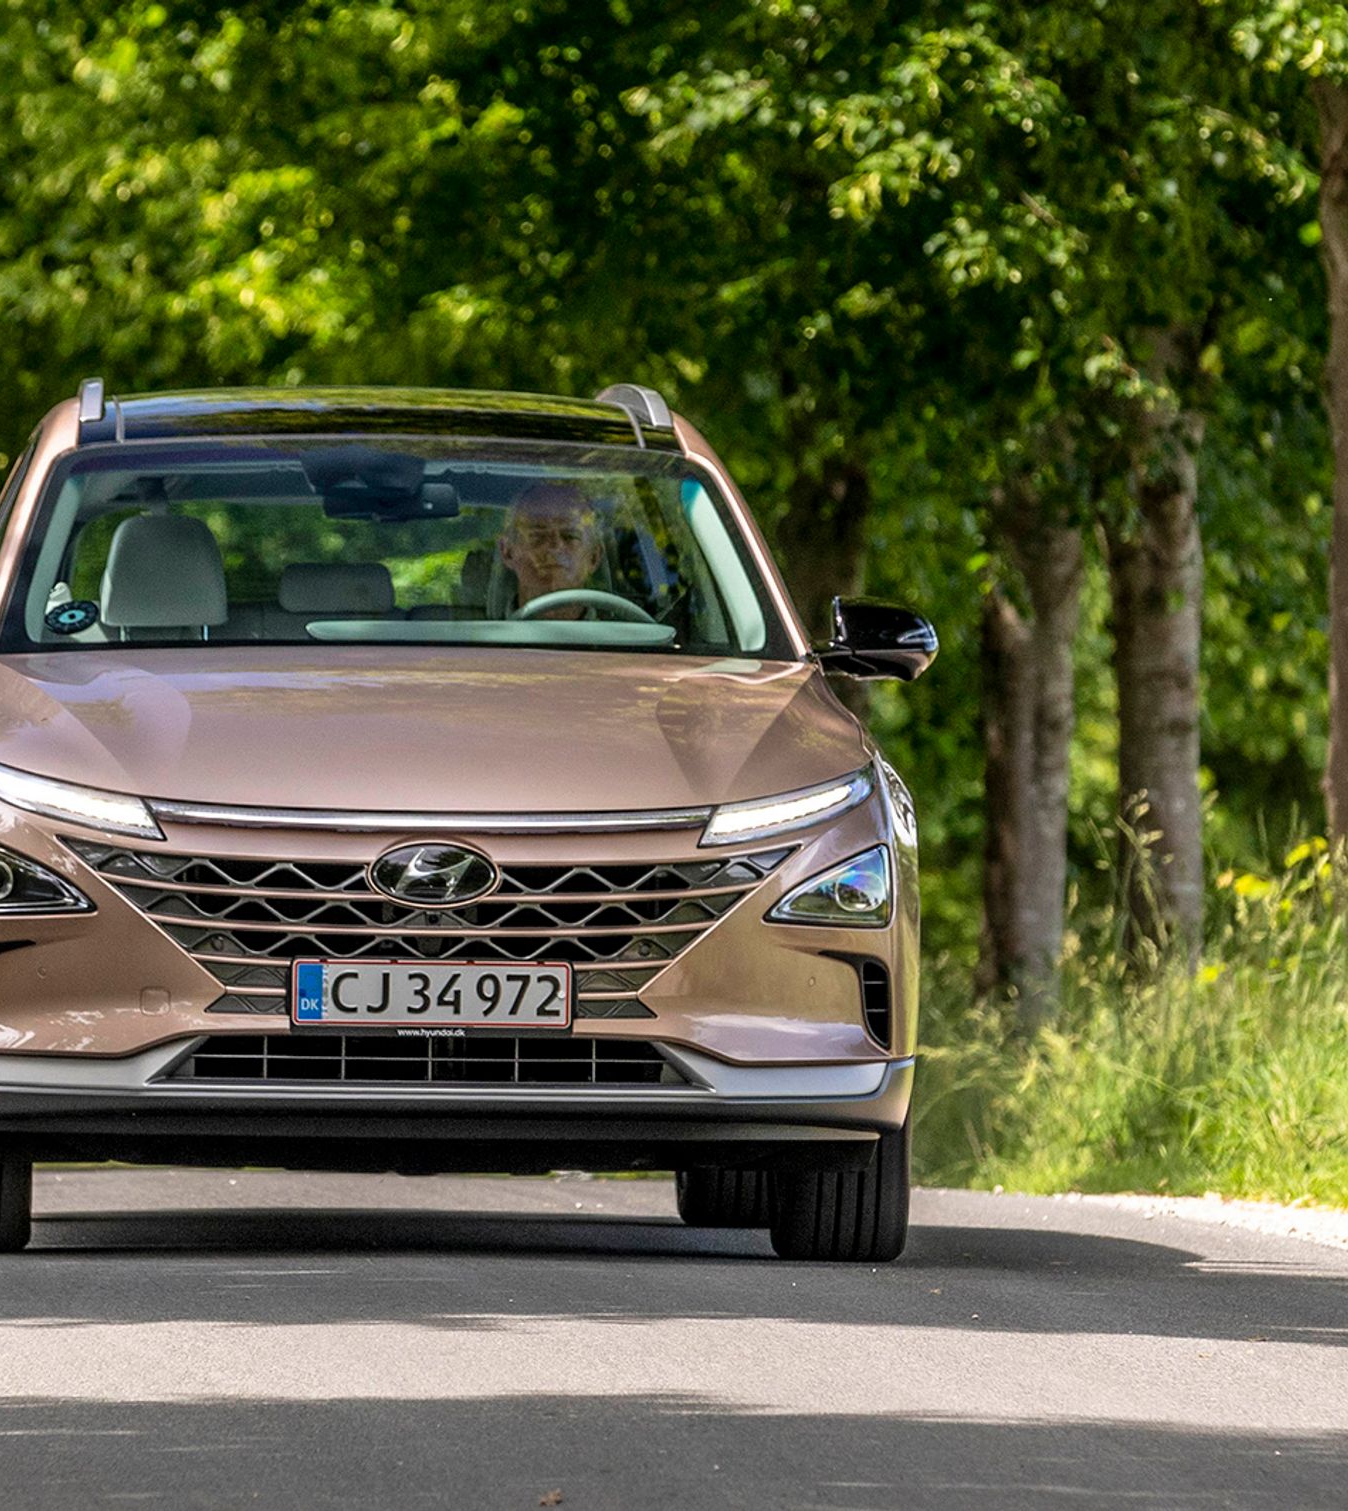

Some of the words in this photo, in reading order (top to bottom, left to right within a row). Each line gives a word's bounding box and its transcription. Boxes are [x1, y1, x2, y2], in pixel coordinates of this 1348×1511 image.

[331, 971, 390, 1014] CJ
[406, 972, 462, 1015] 34
[475, 973, 562, 1017] 972
[300, 997, 319, 1011] DK
[396, 1028, 466, 1038] www.hyundai.dk
